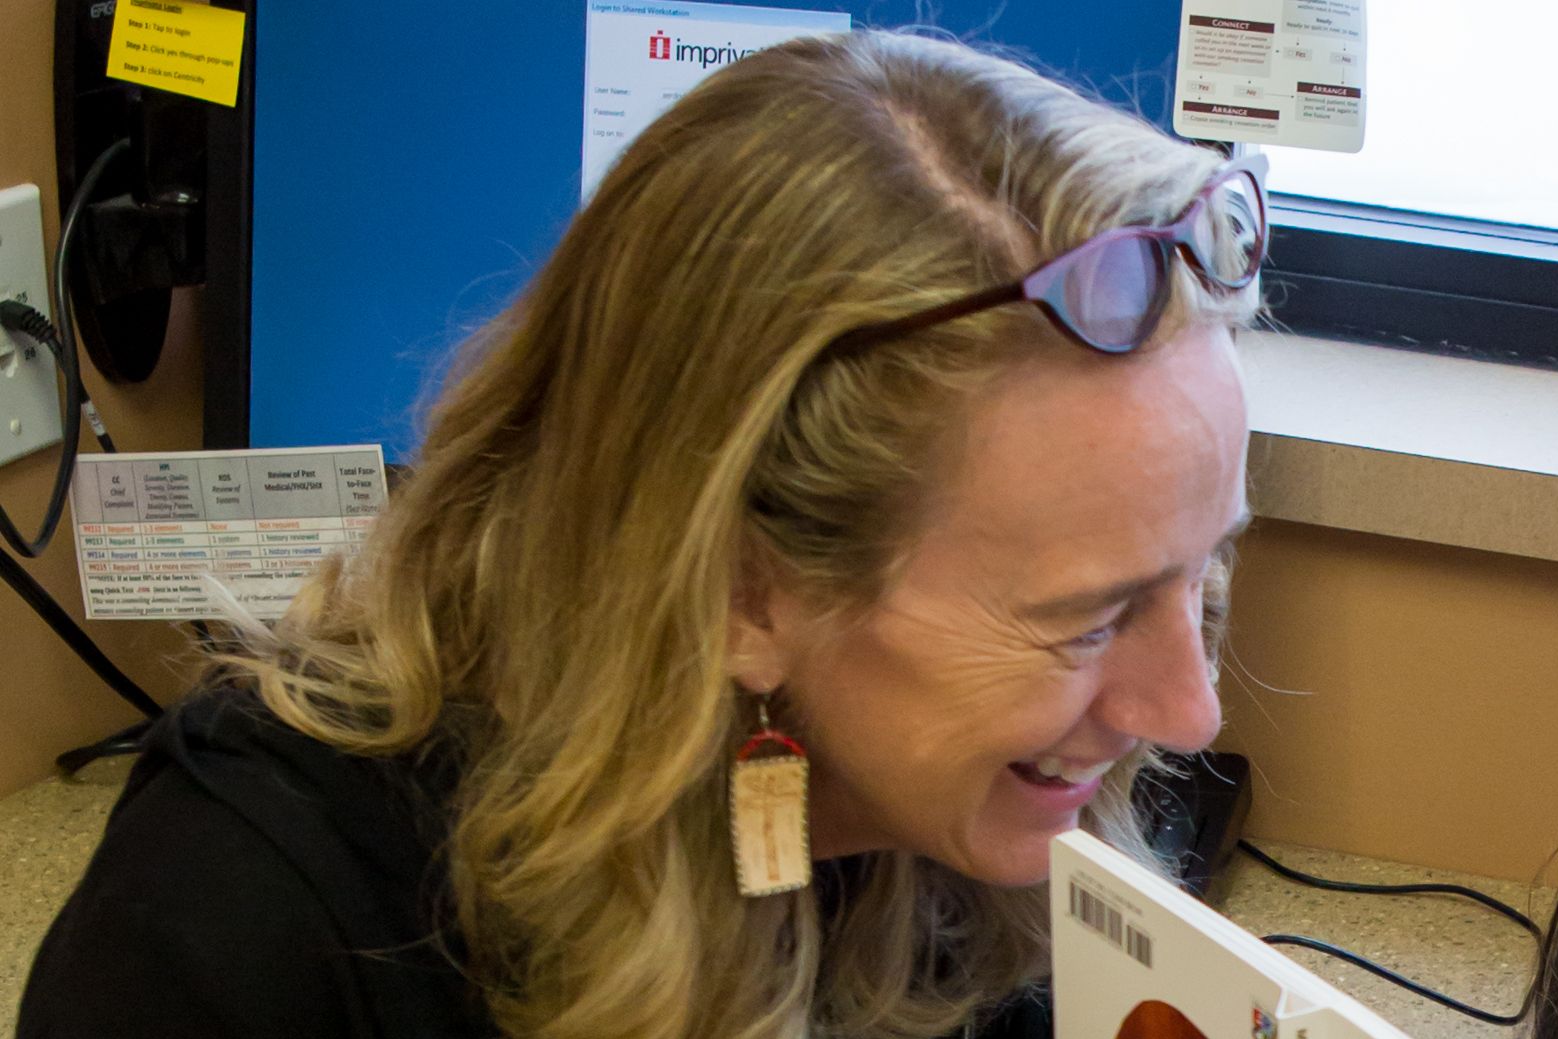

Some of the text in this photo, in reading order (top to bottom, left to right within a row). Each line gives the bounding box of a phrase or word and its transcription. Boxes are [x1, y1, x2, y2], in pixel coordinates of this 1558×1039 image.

[591, 3, 610, 13] Login
[622, 5, 646, 15] Shared
[647, 7, 690, 17] Workstation
[128, 19, 191, 37] Step 1: Tap to login
[1211, 18, 1250, 30] CONNECT
[125, 41, 234, 67] Step 2: Click yes through pop-ups
[124, 62, 139, 73] Step
[140, 65, 147, 74] 3:
[147, 66, 162, 76] click
[173, 71, 205, 85] Centricity
[267, 470, 292, 479] Review
[292, 469, 301, 479] of
[339, 467, 357, 476] Total
